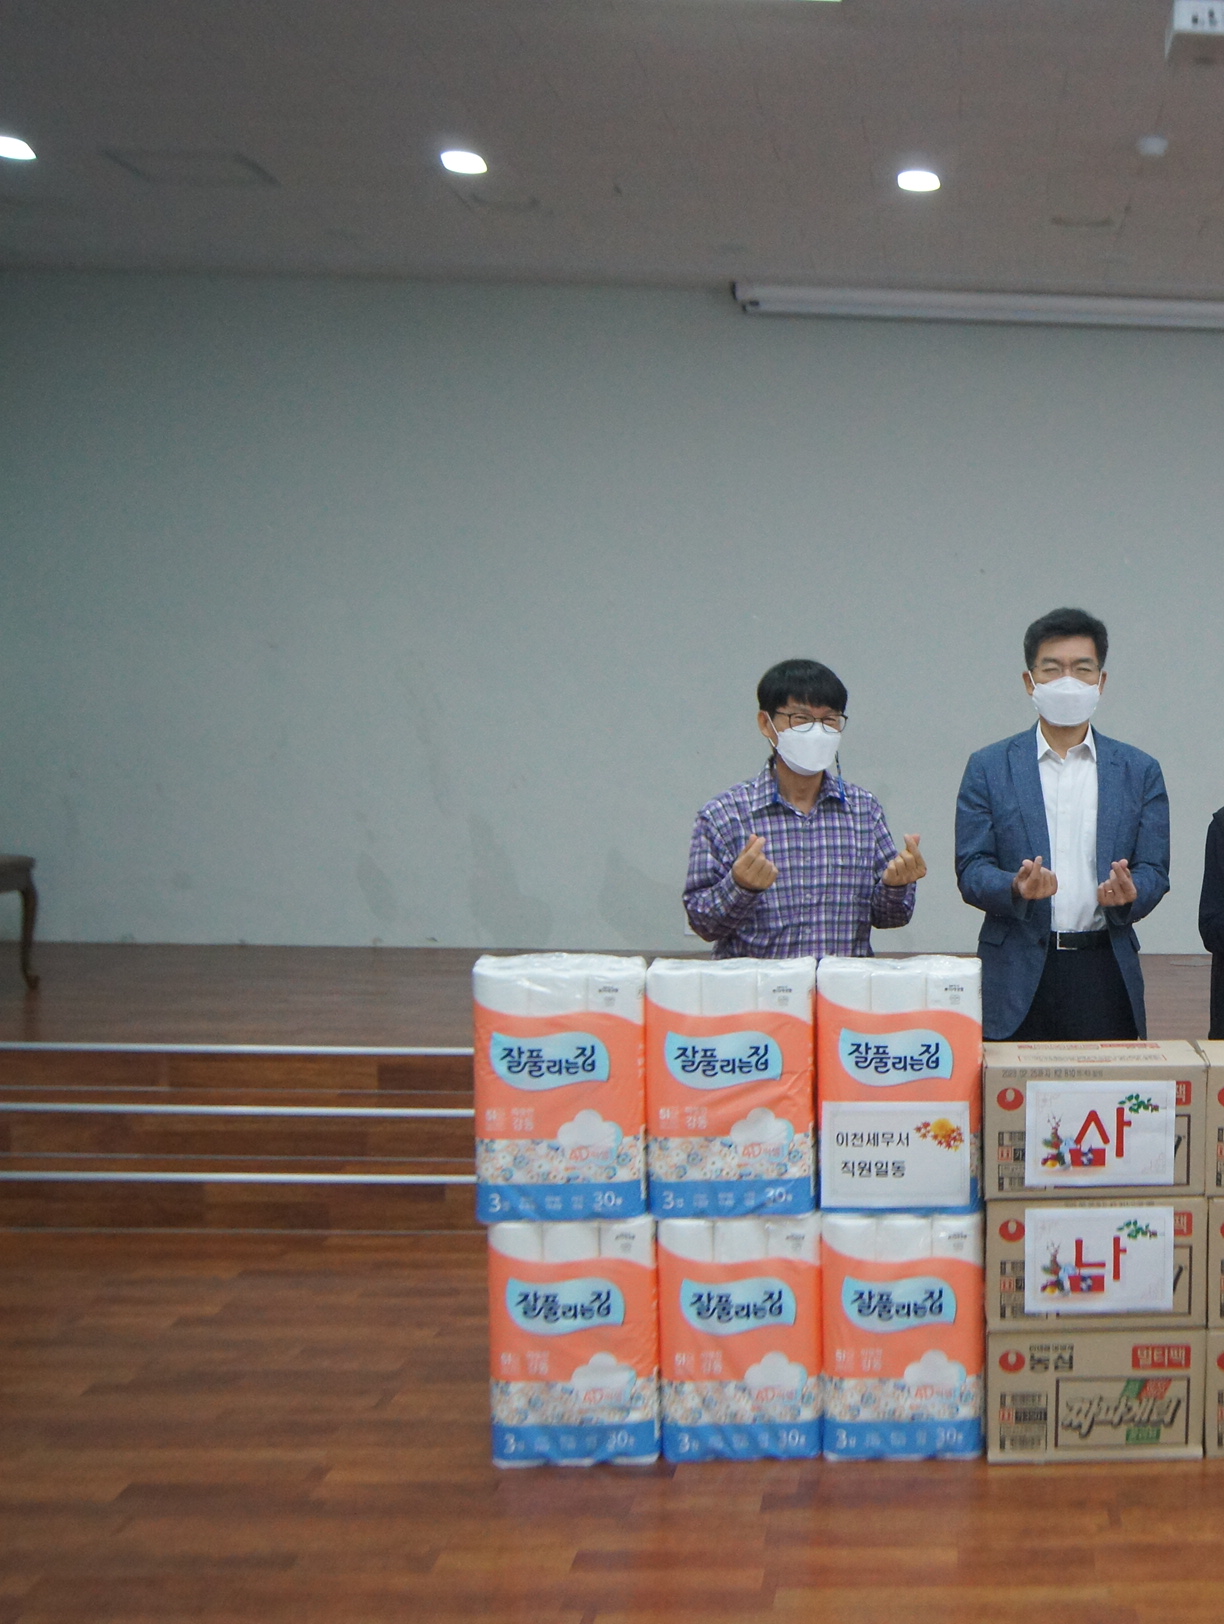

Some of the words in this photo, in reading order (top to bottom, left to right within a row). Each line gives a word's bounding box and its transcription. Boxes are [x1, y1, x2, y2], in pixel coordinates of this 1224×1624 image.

[501, 1044, 596, 1078] 잘풀리는집
[674, 1043, 770, 1078] 잘풀리는집
[848, 1042, 940, 1074] 잘풀리는집
[836, 1132, 910, 1148] 이천세무서
[1074, 1107, 1132, 1159] 사
[841, 1160, 906, 1178] 직원일동
[1075, 1236, 1127, 1281] 나
[516, 1289, 611, 1324] 잘풀리는집
[689, 1289, 784, 1324] 잘풀리는집
[851, 1288, 944, 1322] 잘풀리는집
